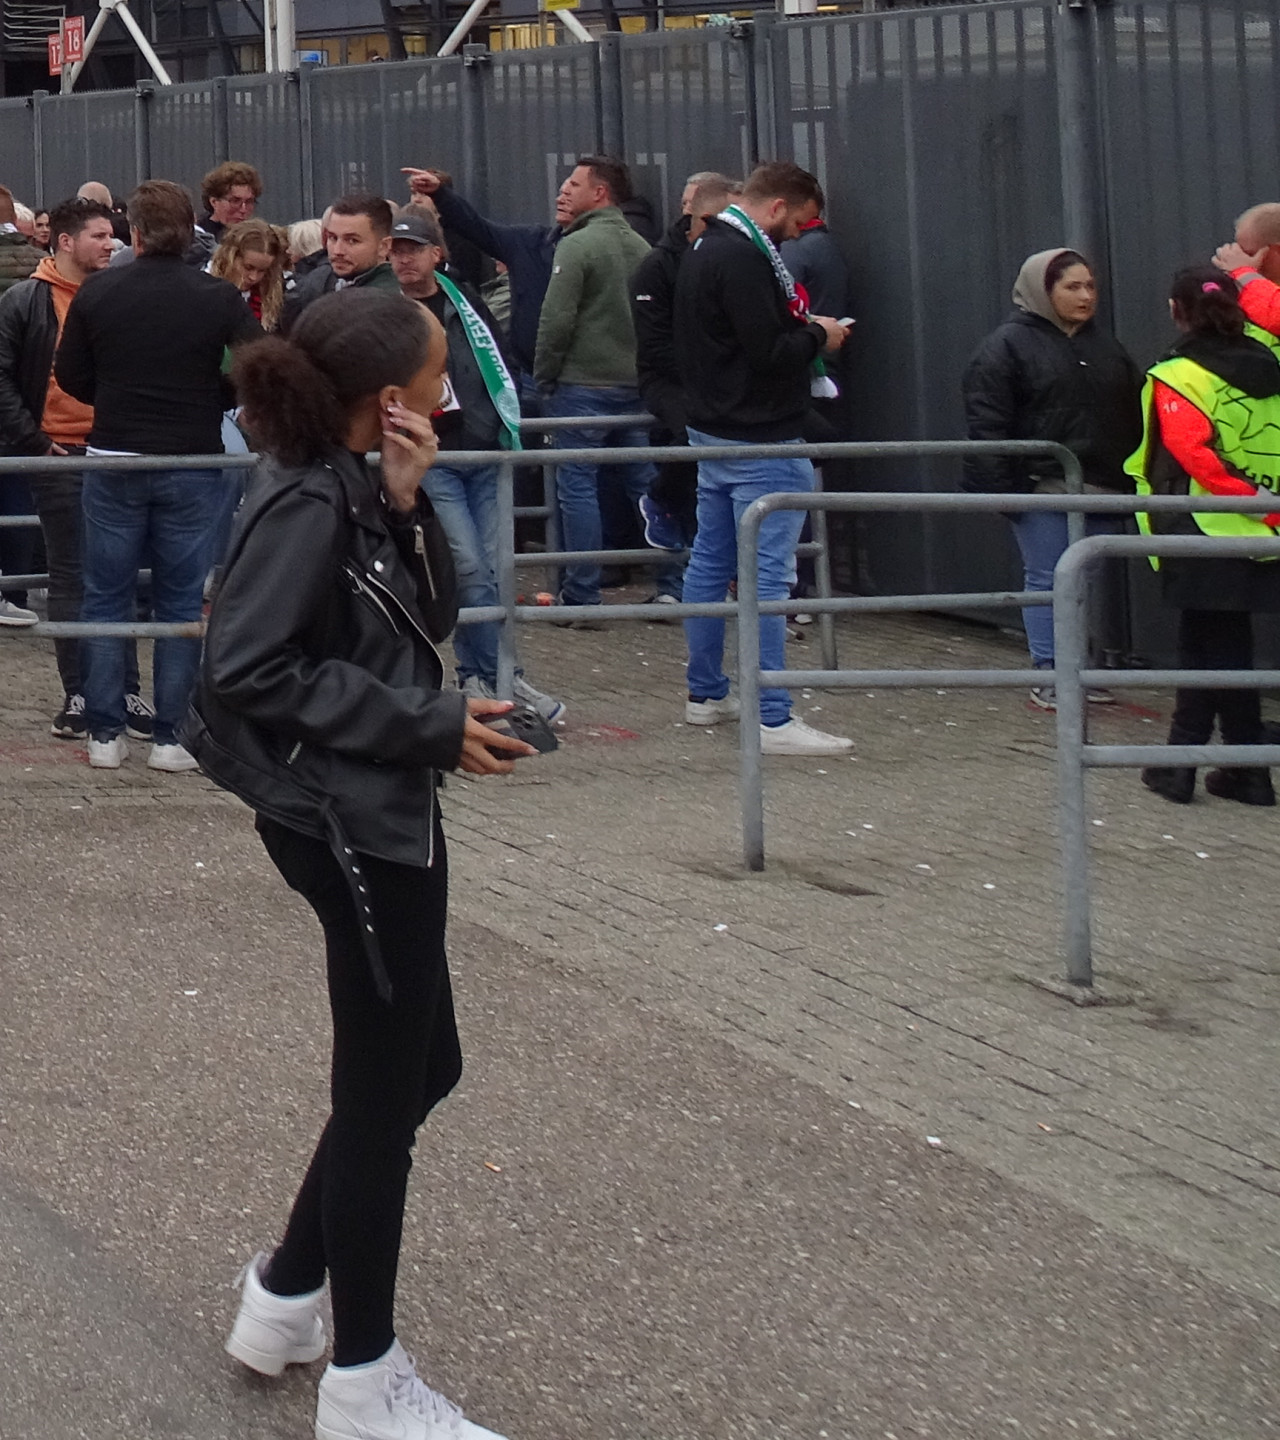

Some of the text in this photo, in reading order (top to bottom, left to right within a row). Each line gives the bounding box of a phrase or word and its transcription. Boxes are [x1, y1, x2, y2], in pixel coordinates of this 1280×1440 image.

[67, 29, 80, 53] 18
[51, 45, 61, 66] 17
[1163, 401, 1179, 414] 16
